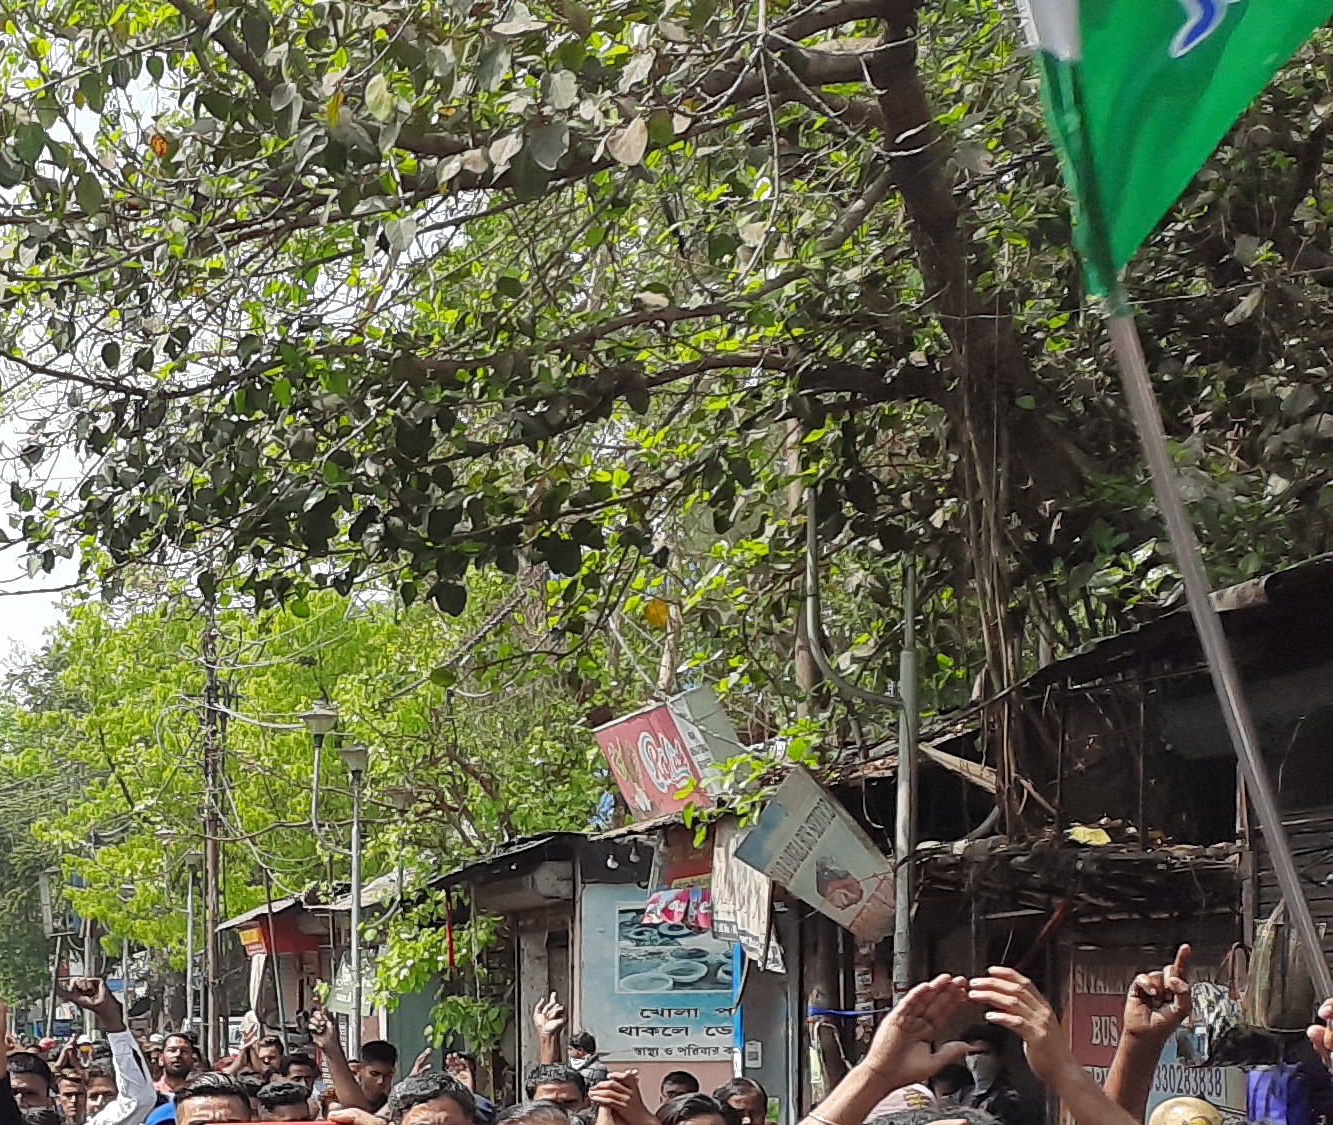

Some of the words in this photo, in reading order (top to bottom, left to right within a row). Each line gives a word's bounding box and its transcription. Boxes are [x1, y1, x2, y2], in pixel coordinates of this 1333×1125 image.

[640, 1007, 699, 1019] খোলা
[618, 1026, 691, 1037] থাকলে
[704, 1026, 734, 1037] ডে
[1091, 1015, 1119, 1047] BUS
[1155, 1064, 1222, 1097] 330283838
